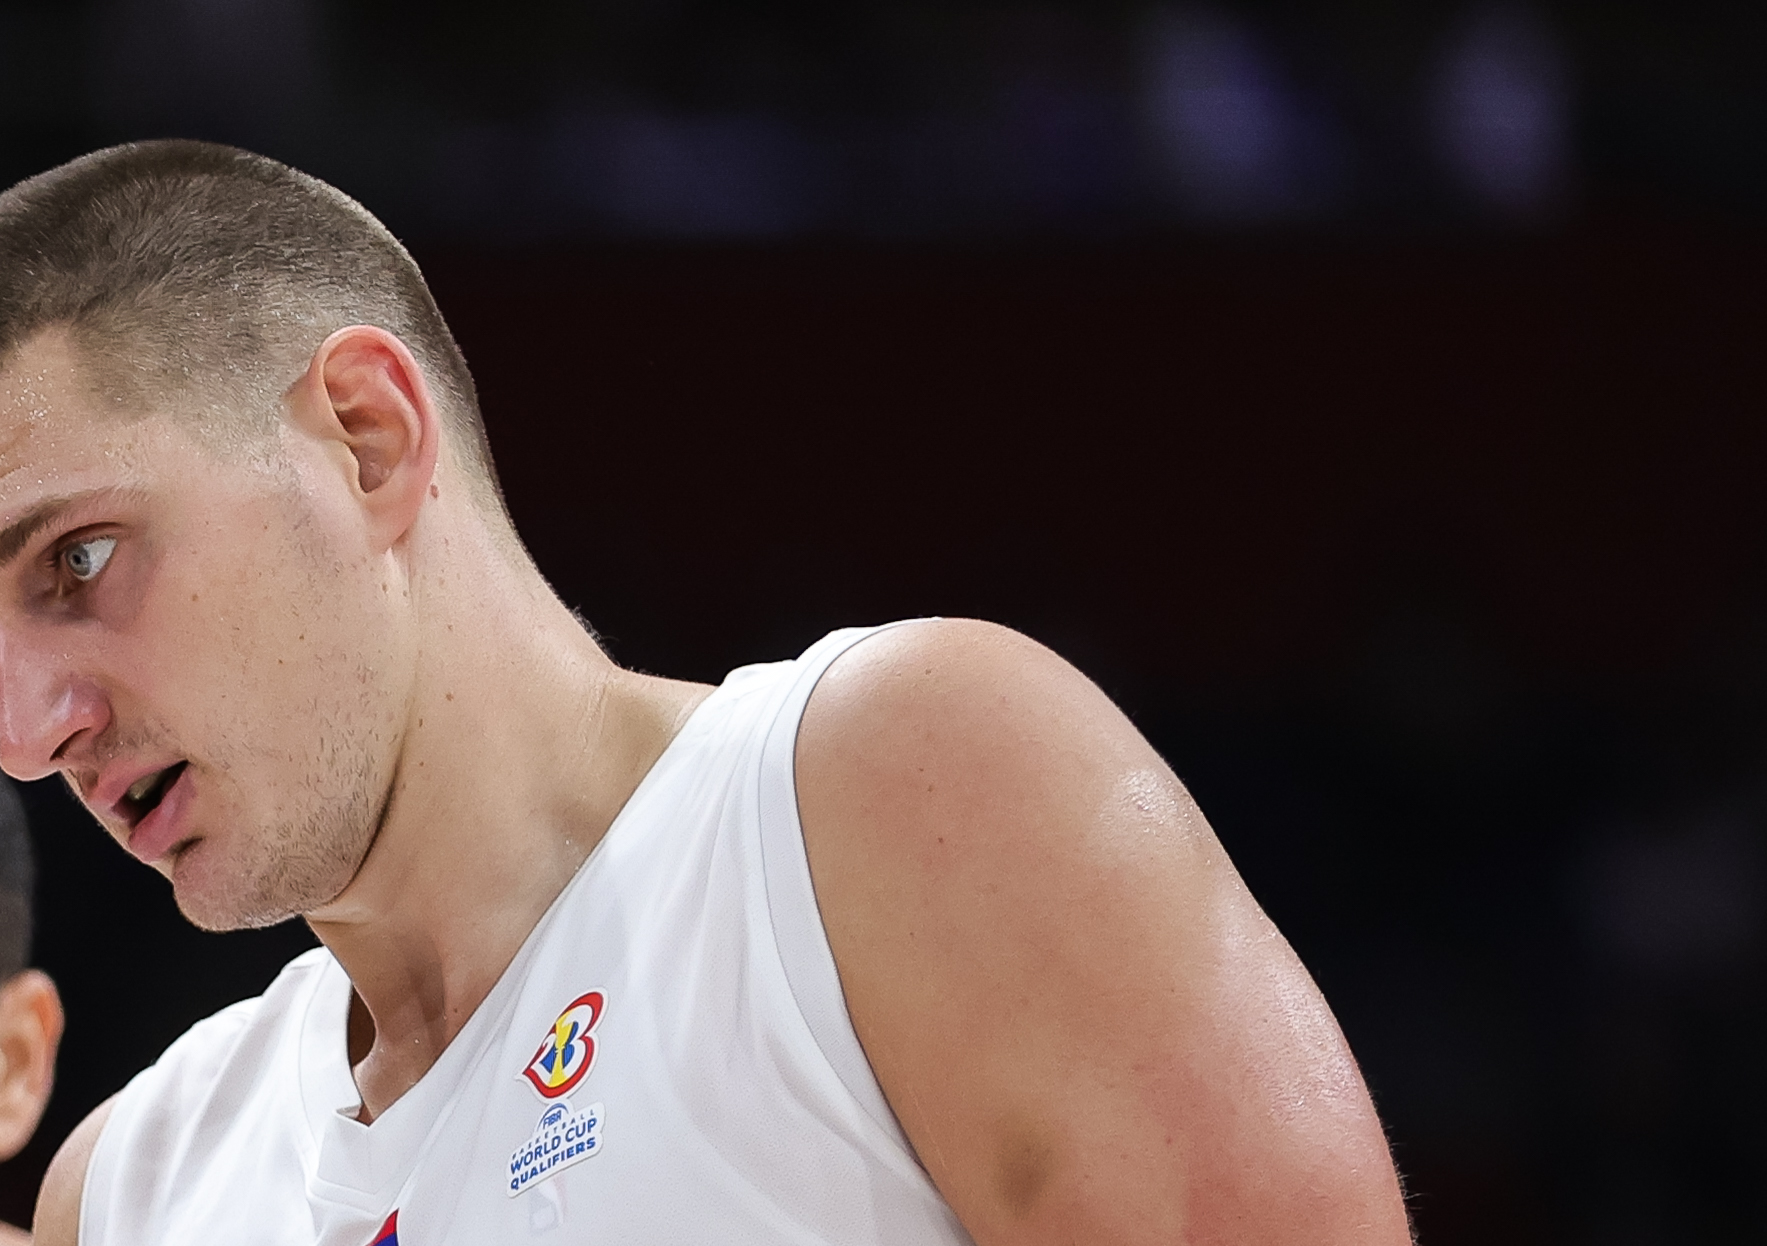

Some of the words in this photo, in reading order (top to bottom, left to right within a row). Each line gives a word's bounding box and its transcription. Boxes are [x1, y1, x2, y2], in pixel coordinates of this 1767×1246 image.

[510, 1136, 561, 1175] WORLD
[565, 1117, 598, 1143] CUP
[510, 1136, 596, 1191] QUALIFIERS
